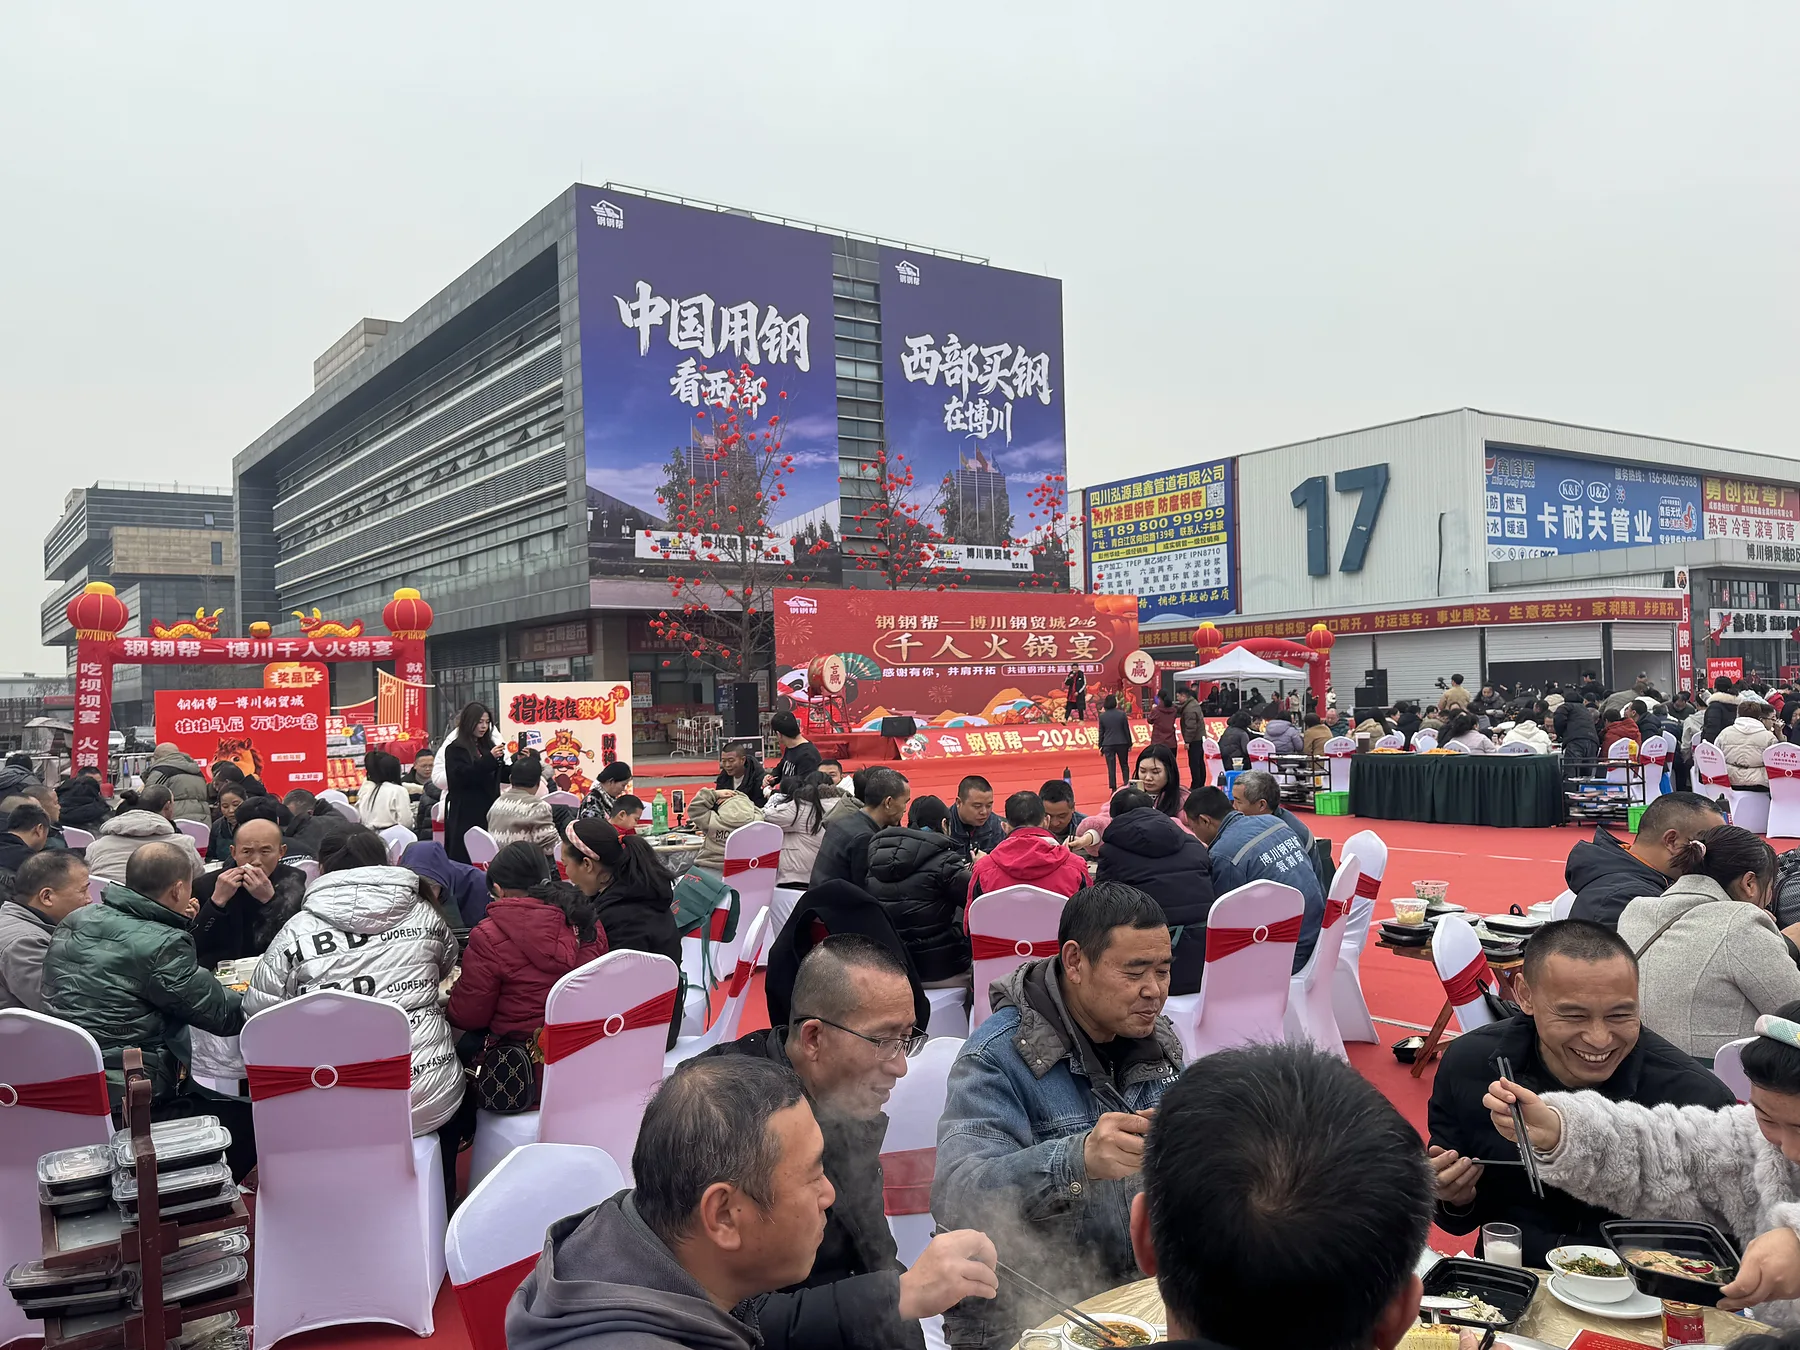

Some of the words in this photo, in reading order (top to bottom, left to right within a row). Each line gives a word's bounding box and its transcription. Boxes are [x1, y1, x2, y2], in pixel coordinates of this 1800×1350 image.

[614, 280, 810, 372] 中国用钢
[901, 333, 1053, 405] 西部买钢
[669, 356, 768, 420] 看西部
[943, 401, 1013, 446] 在博川
[1090, 464, 1225, 506] 四川泓源晟鑫管道有限公司
[1648, 472, 1698, 488] 136-8402-5988
[1506, 496, 1525, 511] 燃气
[1589, 485, 1607, 499] U&Z
[1706, 477, 1795, 508] 勇创拉弯厂
[1108, 523, 1134, 537] 189
[1139, 517, 1168, 532] 800
[1172, 507, 1225, 526] 99999
[1290, 463, 1391, 576] 17
[1507, 520, 1526, 535] 暖通
[1537, 501, 1653, 543] 卡耐夫管业
[1708, 515, 1727, 536] 热弯
[1731, 517, 1750, 538] 冷弯
[1755, 519, 1773, 540] 滚弯
[1777, 521, 1795, 541] 顶弯
[1126, 559, 1142, 567] TPEP
[1174, 552, 1187, 561] 3PE
[1190, 547, 1221, 558] IPN8710
[1097, 570, 1130, 581] 油两布
[123, 640, 394, 658] 钢钢帮—博川千人火锅宴
[885, 632, 1099, 662] 千人火锅宴
[277, 671, 317, 684] 奖品区
[250, 713, 320, 732] 万事如意
[380, 927, 422, 942] CUORENT
[387, 979, 428, 993] CUORENT
